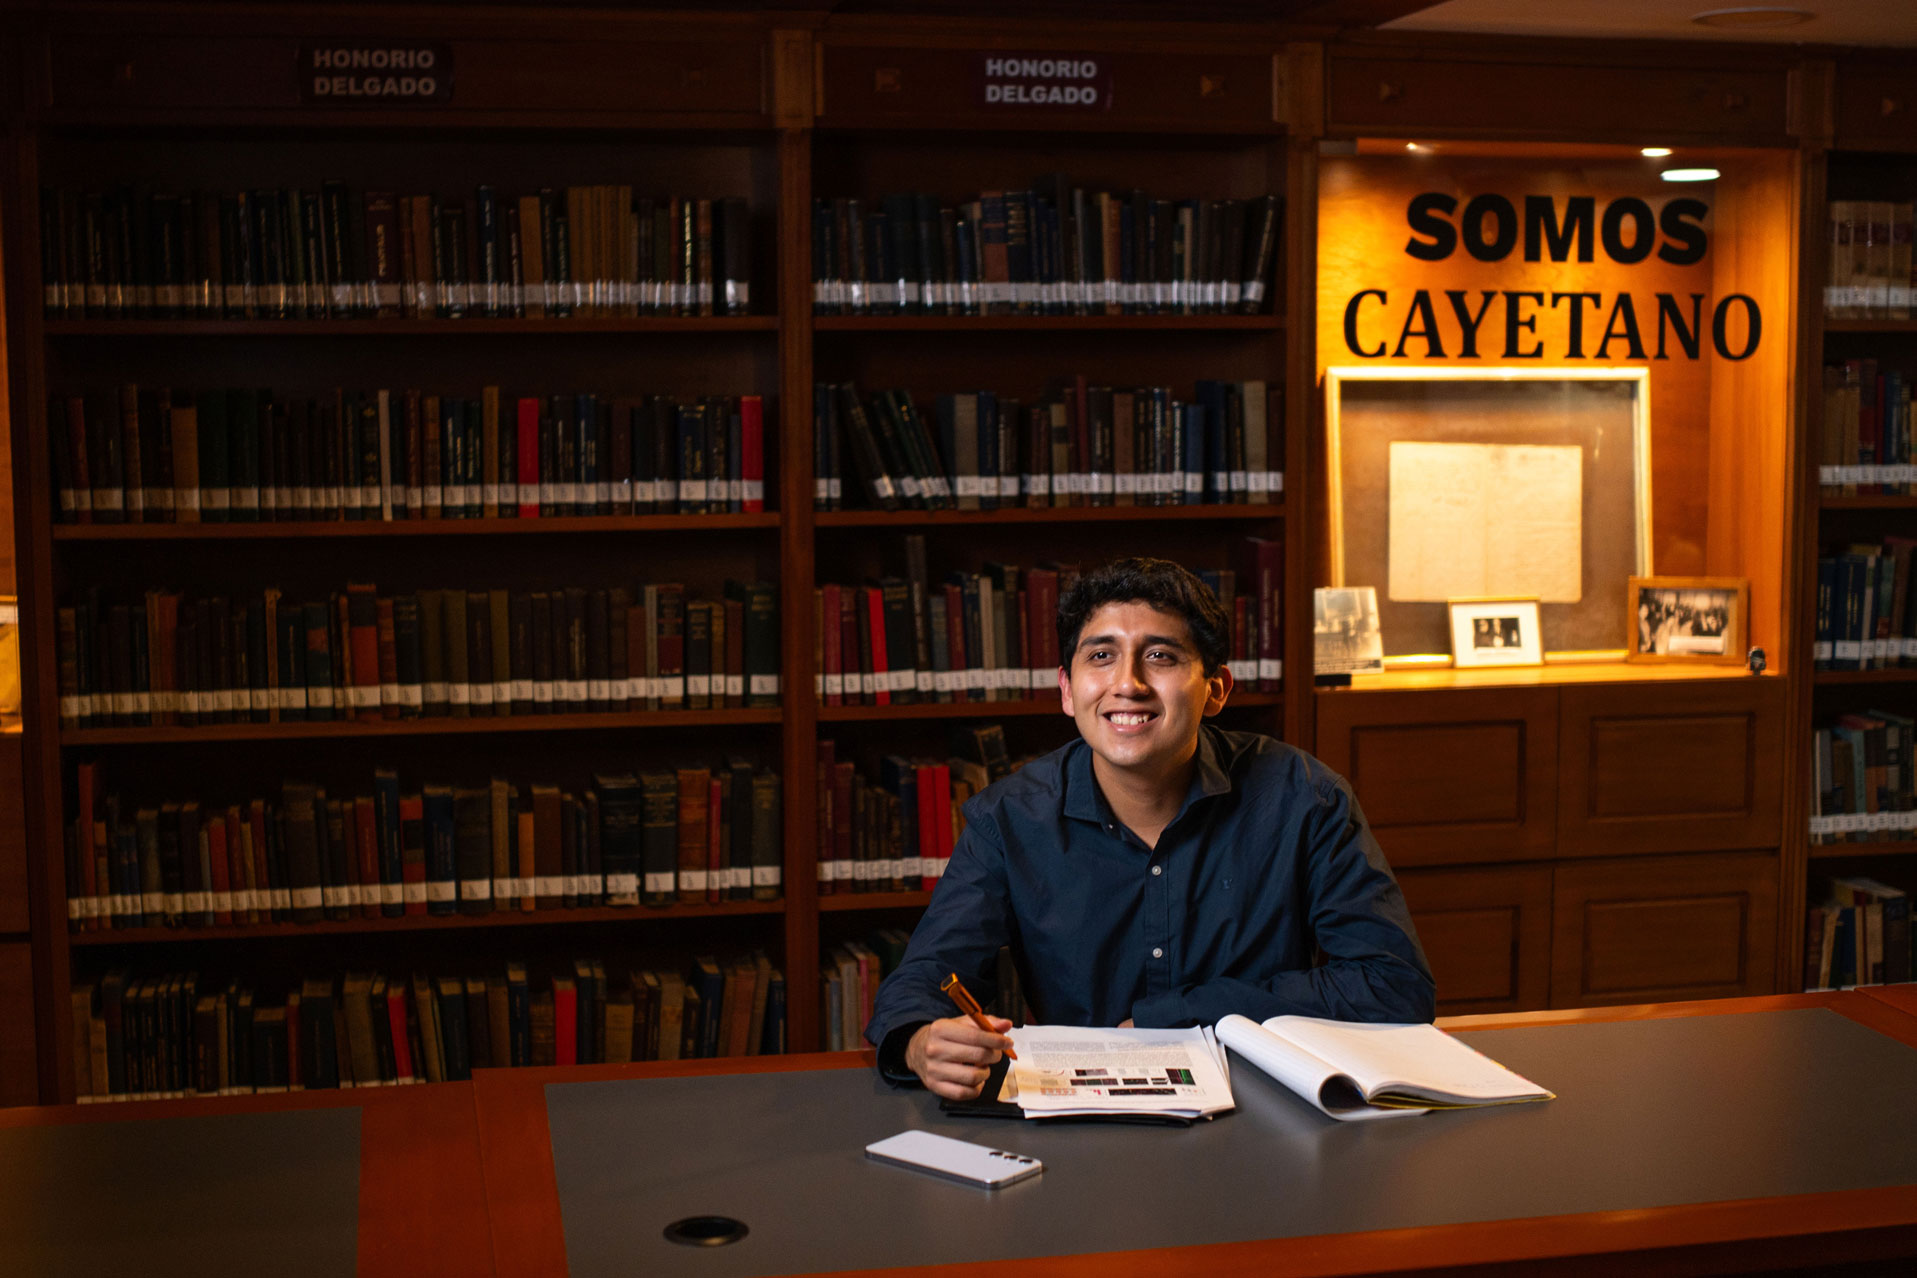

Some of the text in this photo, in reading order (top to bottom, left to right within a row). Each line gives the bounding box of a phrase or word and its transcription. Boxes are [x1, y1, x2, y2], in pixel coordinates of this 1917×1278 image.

[313, 49, 435, 68] HONORIO
[985, 58, 1098, 78] HONORIO
[313, 76, 437, 96] DELGADO
[985, 84, 1098, 104] DELGADO
[1404, 192, 1709, 265] SOMOS
[1343, 289, 1762, 362] CAYETANO
